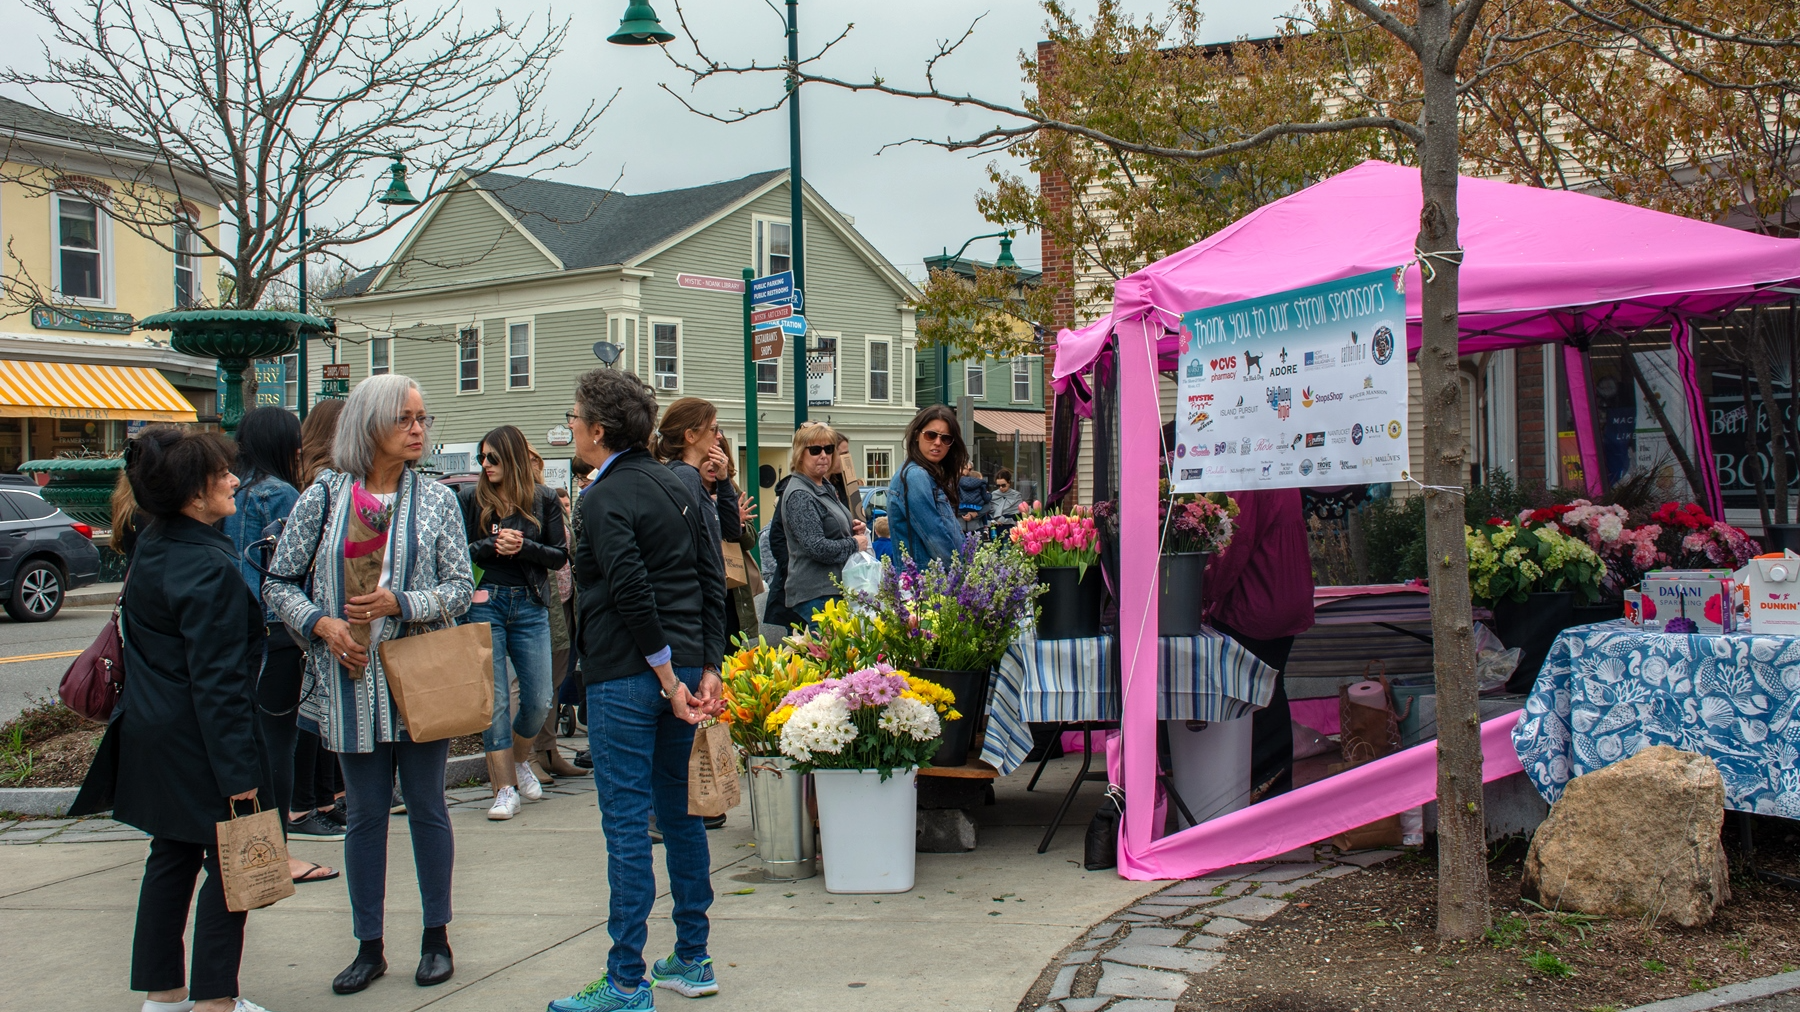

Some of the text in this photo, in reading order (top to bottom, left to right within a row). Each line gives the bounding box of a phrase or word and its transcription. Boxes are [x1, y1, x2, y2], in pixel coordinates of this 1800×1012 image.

[684, 278, 702, 286] MYSTIC
[706, 280, 721, 288] NOANK
[721, 281, 740, 290] LIBRARY
[754, 278, 784, 290] PUBLIC PARKING
[754, 286, 789, 299] PUBLIC RESTROOMS
[754, 312, 767, 321] MYSTIC
[775, 308, 789, 317] CENTER
[1194, 283, 1385, 349] thank you to our stroll sponsors
[781, 320, 802, 329] STATION
[755, 332, 778, 344] RESTAURANTS
[761, 345, 772, 356] SHOPS
[1219, 356, 1236, 370] CVS
[327, 366, 348, 376] SHOPS/FOOD
[1270, 364, 1298, 377] ADORE
[1211, 372, 1236, 383] pharmacy
[322, 382, 341, 392] PEARL
[1188, 394, 1214, 402] MYSTIC
[1315, 392, 1344, 404] Stop&Shop
[1349, 391, 1365, 400] SPICER
[1191, 402, 1212, 410] Pizza
[1220, 406, 1259, 416] ISLAND PURSUIT
[49, 408, 109, 419] GALLERY
[1188, 412, 1198, 420] SLICE
[1197, 420, 1213, 432] HEAVEN
[1365, 424, 1385, 434] SALT
[1327, 428, 1350, 436] NANTUCKET
[1254, 438, 1273, 451] Rose
[1375, 454, 1400, 463] MALLOVE'S
[1659, 584, 1701, 599] DASANI
[1761, 602, 1800, 610] DUNKIN'
